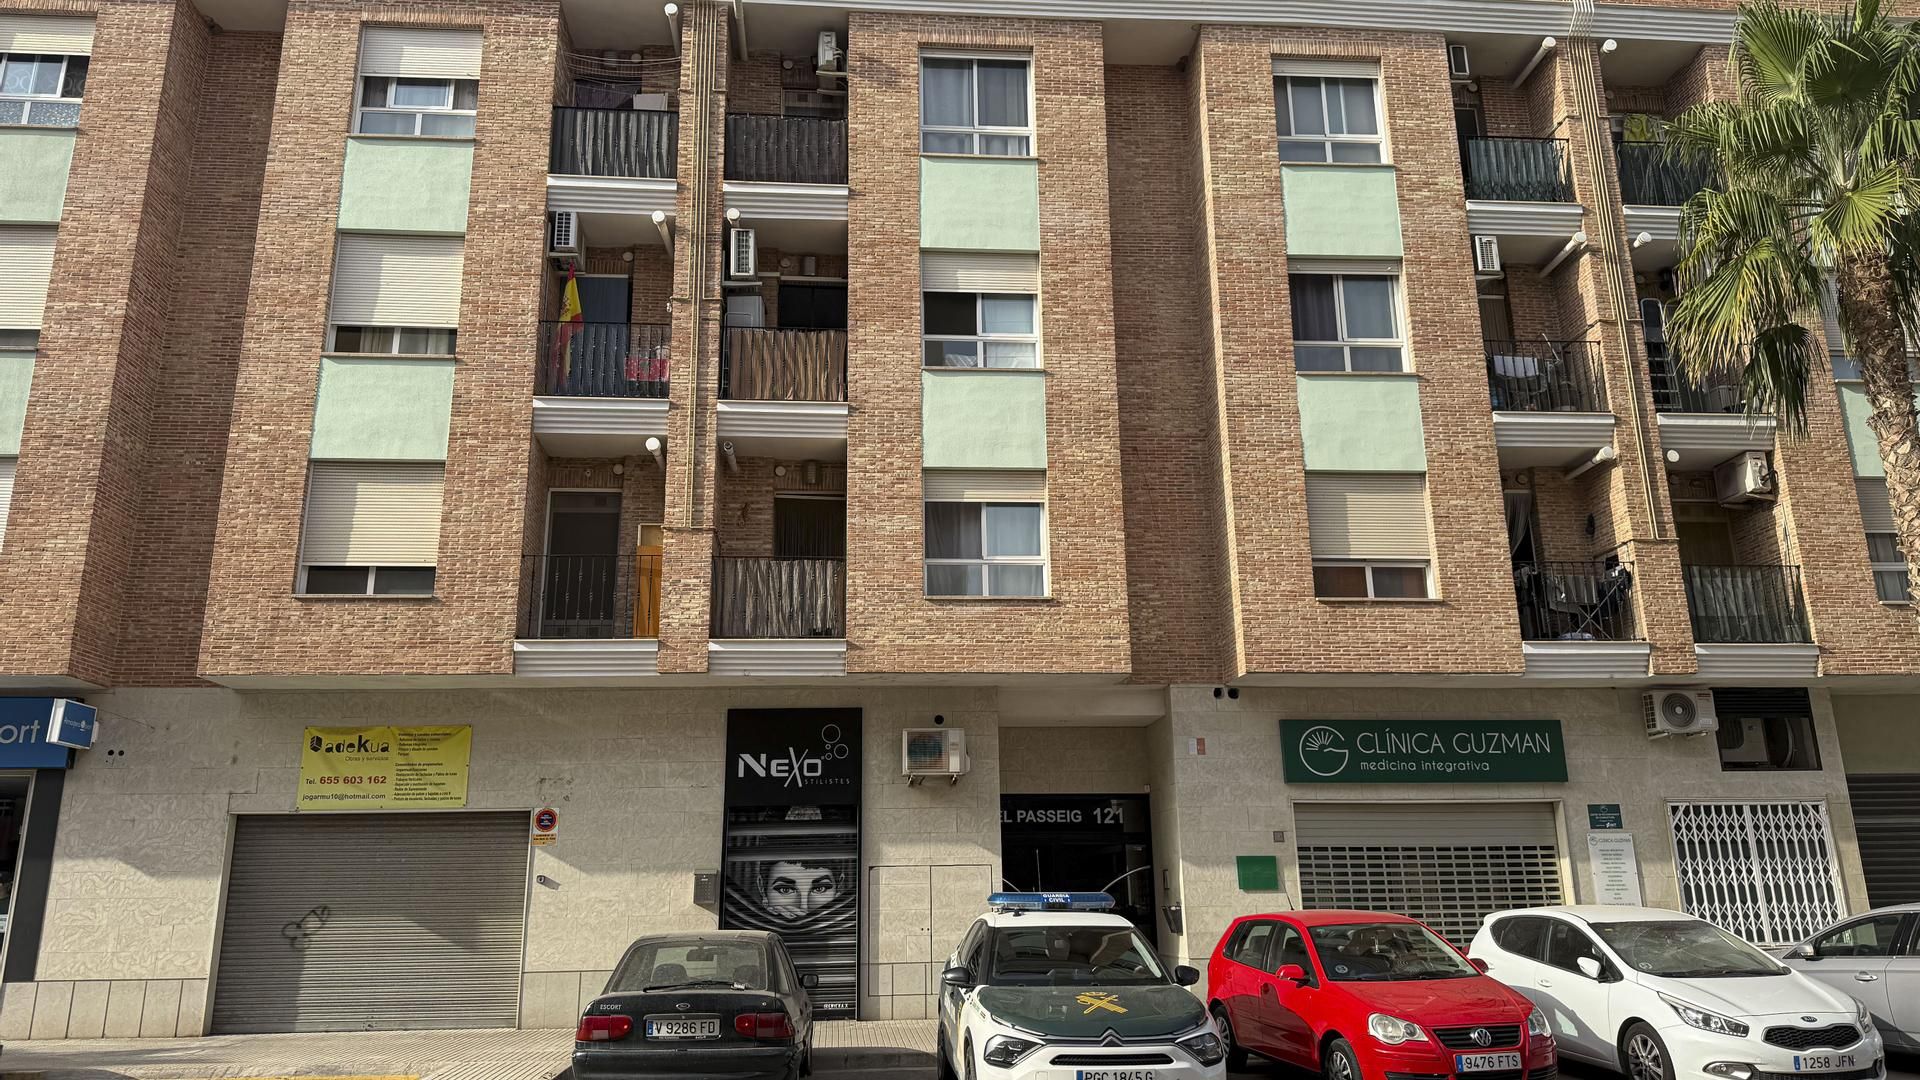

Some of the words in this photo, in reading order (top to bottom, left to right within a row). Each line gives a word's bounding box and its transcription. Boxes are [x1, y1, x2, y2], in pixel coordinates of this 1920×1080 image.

[1356, 728, 1446, 754] CLÍNICA
[1452, 732, 1551, 754] GUZMAN
[1360, 759, 1417, 771] medicina
[1421, 760, 1490, 772] integrativa
[319, 776, 340, 785] 655
[343, 776, 363, 785] 603
[367, 775, 387, 784] 162
[1017, 809, 1082, 822] PASSEIG
[1093, 807, 1124, 824] 121
[655, 1022, 663, 1034] V
[666, 1022, 697, 1034] 9286
[700, 1021, 715, 1034] FD
[1465, 1056, 1495, 1069] 9476
[1497, 1055, 1519, 1068] FTS
[1803, 1057, 1830, 1069] 1258
[1835, 1055, 1855, 1068] JFN
[1085, 1072, 1109, 1080] PGC
[1113, 1072, 1142, 1080] 1845
